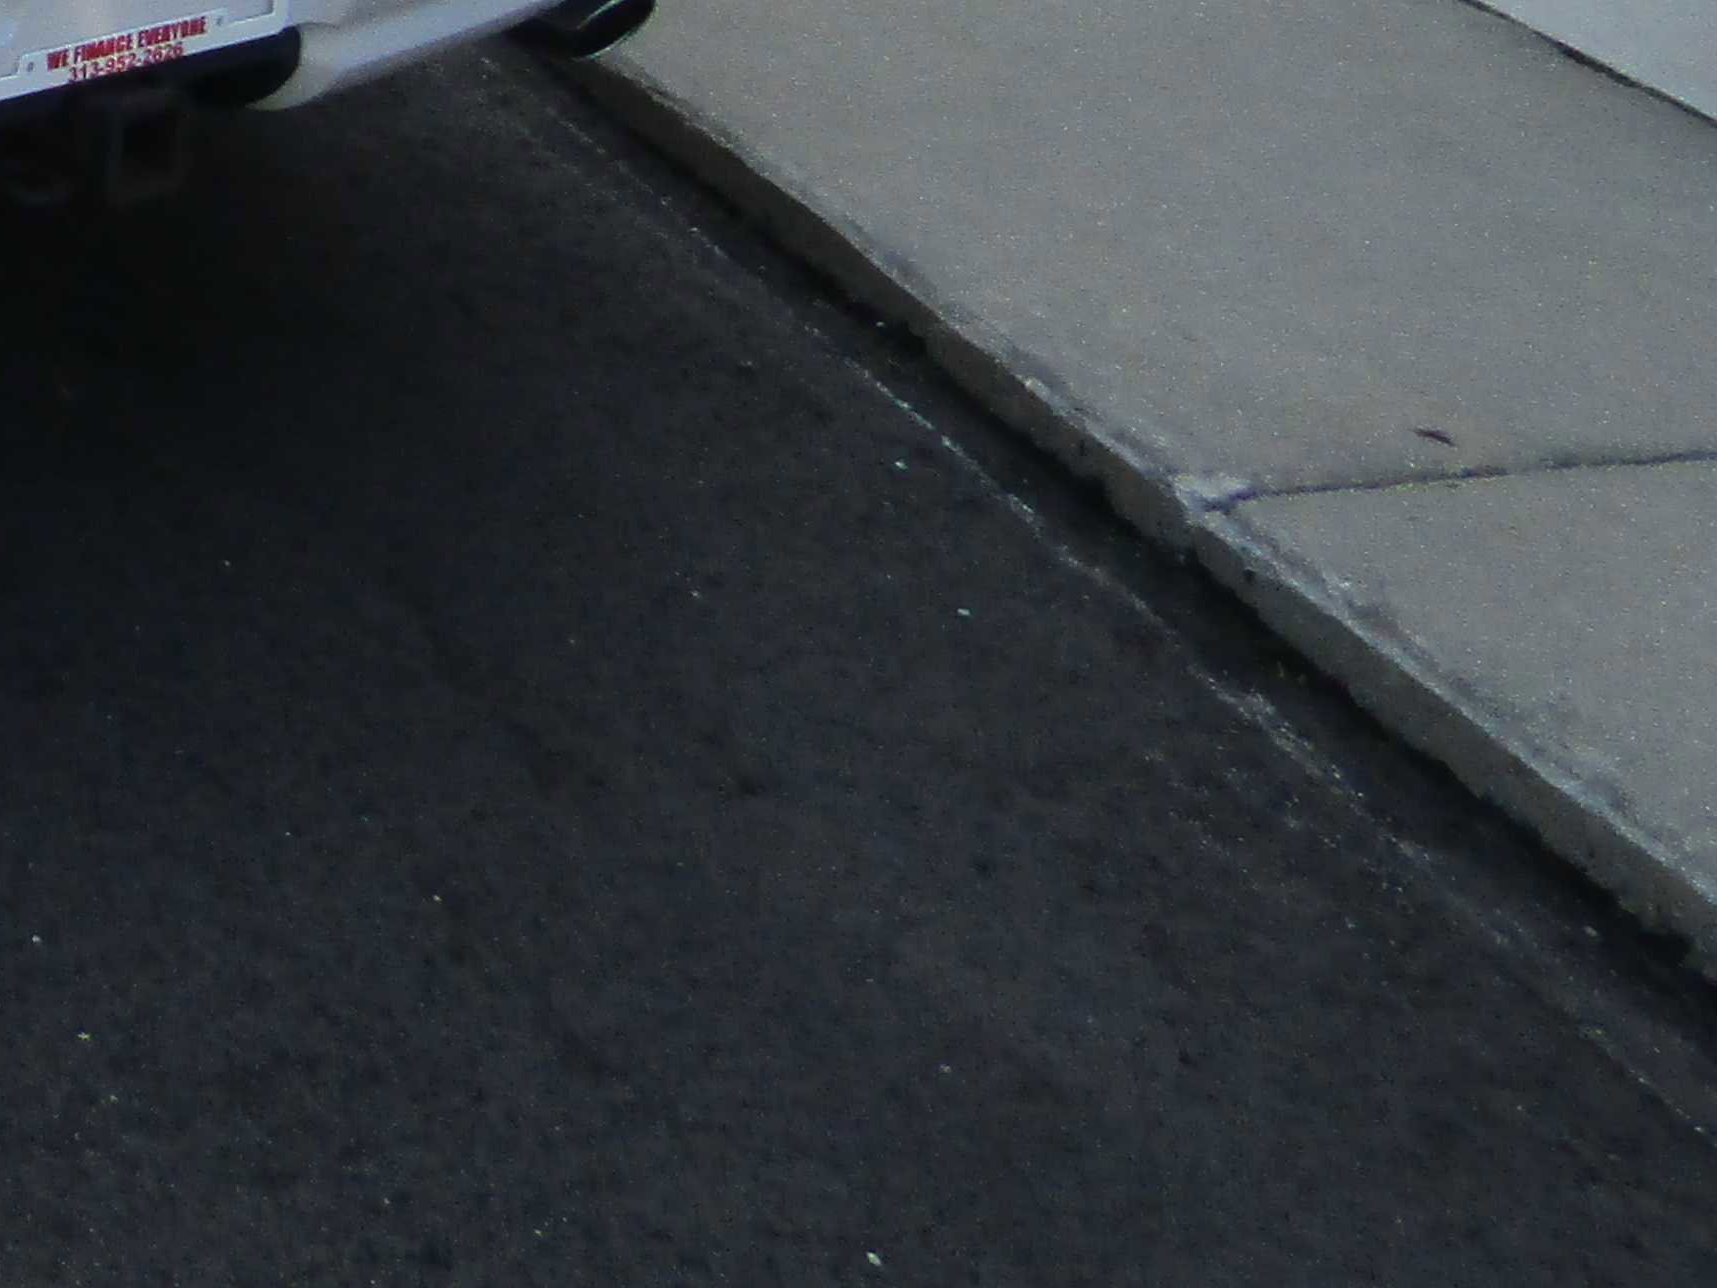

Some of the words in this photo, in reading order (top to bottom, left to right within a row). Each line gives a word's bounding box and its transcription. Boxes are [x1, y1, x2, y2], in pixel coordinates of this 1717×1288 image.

[47, 48, 70, 70] WE
[74, 32, 134, 64] FINANCE
[138, 16, 208, 48] EVERYONE
